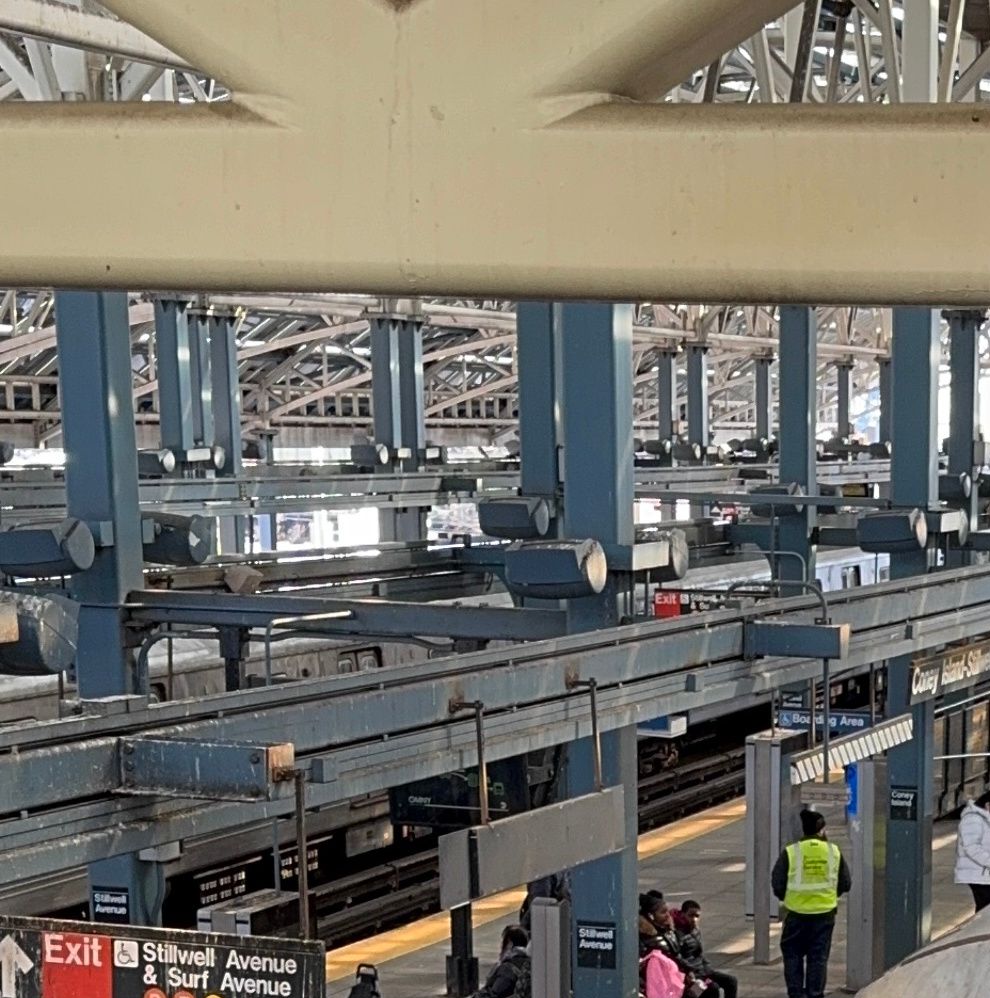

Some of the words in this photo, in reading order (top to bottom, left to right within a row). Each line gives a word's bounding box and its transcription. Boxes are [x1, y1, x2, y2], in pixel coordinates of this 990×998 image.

[655, 593, 677, 605] Exit
[912, 667, 940, 695] Coney
[793, 713, 836, 727] Boadig
[840, 715, 864, 727] Area
[892, 790, 915, 801] Coney
[95, 893, 127, 904] Stillwell
[95, 904, 127, 915] Avenue
[579, 928, 613, 939] Stillwell
[579, 938, 613, 950] Avenue
[45, 934, 102, 967] Exit
[143, 942, 215, 968] Stillwell
[226, 949, 297, 974] Avenue
[143, 964, 158, 985] &
[168, 967, 209, 989] Surf
[220, 972, 292, 996] Avenue
